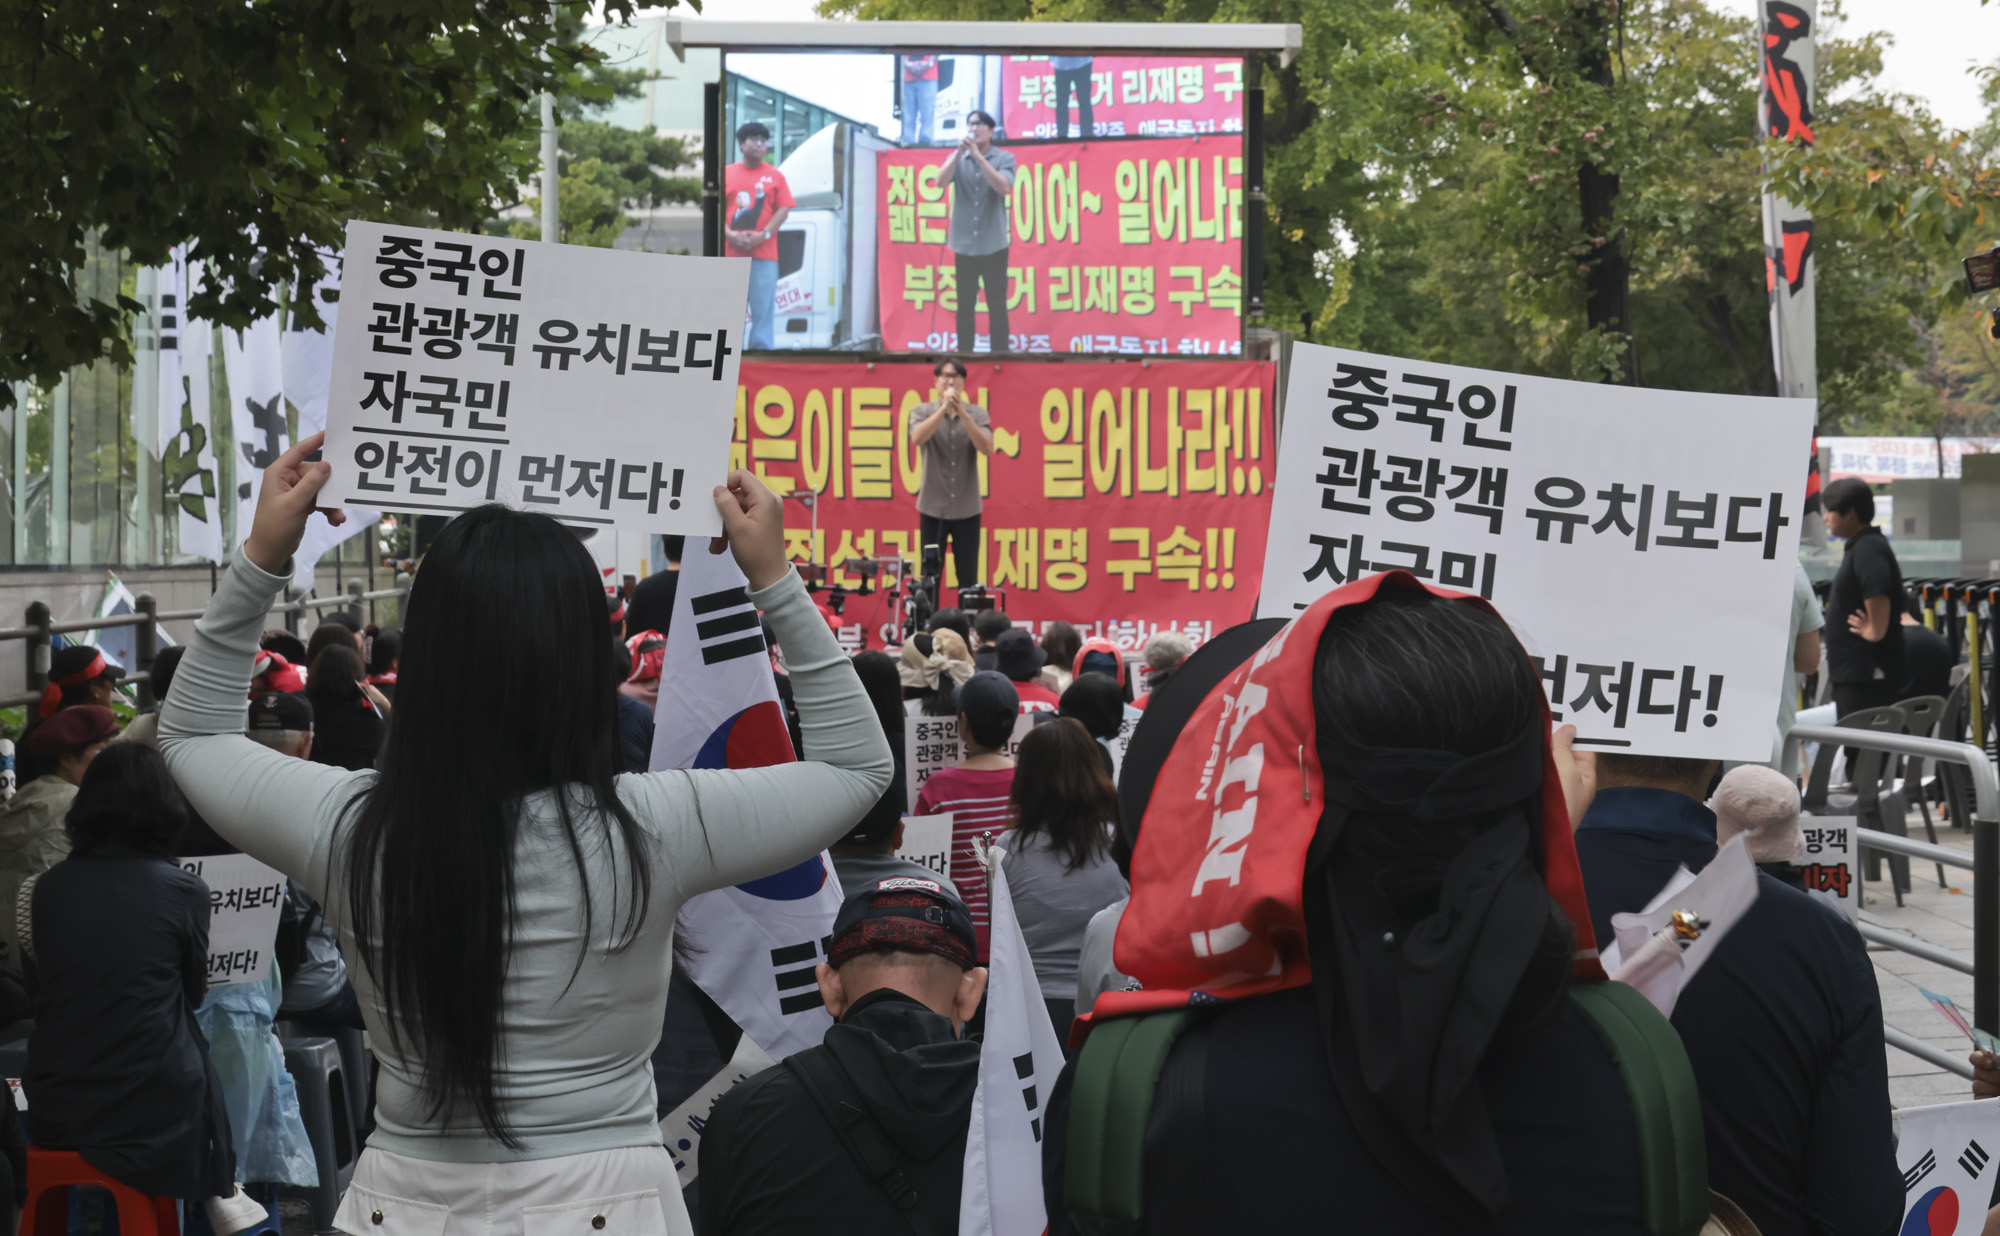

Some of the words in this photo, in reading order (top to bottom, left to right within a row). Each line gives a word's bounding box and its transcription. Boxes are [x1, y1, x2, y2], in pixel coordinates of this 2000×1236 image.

[1122, 64, 1205, 105] 리재명
[887, 160, 1102, 245] 젊은이여~
[376, 235, 525, 301] 중국인
[903, 263, 1037, 314] 부정거
[1049, 264, 1156, 316] 리재명
[367, 302, 519, 366] 관광객
[532, 319, 732, 381] 유치보다
[359, 370, 511, 432] 자국민
[1327, 362, 1517, 452] 중국인
[1040, 386, 1263, 499] 일어나라!!
[354, 441, 502, 500] 안전이
[518, 454, 685, 515] 먼저다!
[1316, 446, 1508, 535] 관광객
[1525, 476, 1789, 560] 유치보다
[1105, 525, 1237, 592] 구속!!
[915, 721, 959, 741] 중국인
[915, 742, 959, 763] 관광객
[1802, 828, 1848, 854] 광객
